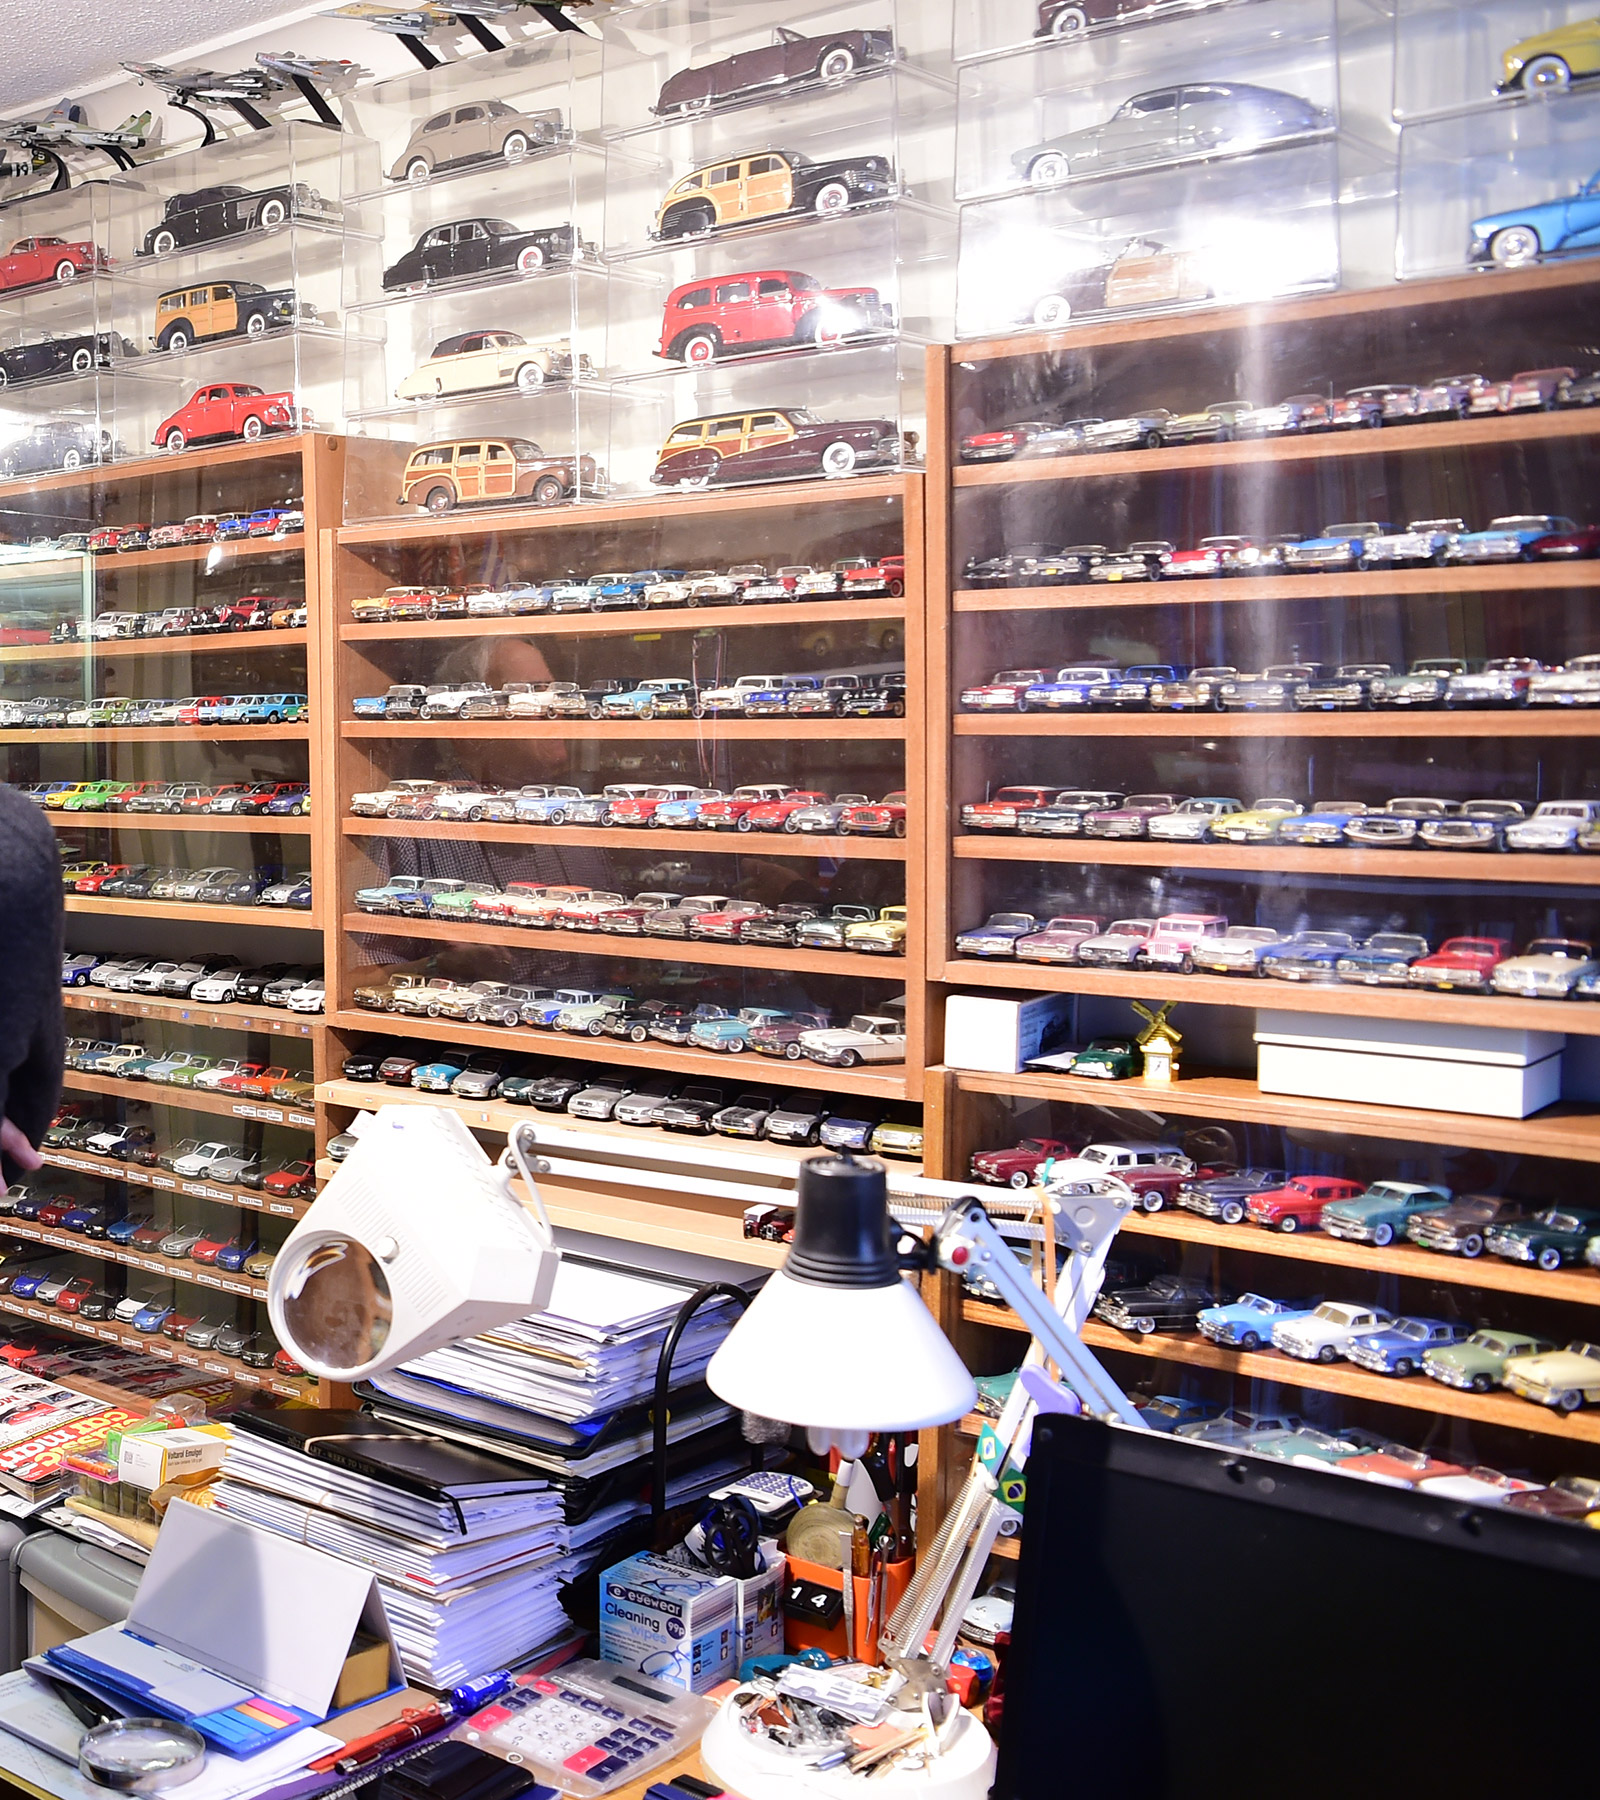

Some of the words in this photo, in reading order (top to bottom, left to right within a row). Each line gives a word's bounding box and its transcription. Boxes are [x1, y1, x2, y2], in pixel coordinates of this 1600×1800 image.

[70, 1411, 129, 1434] car
[167, 1449, 185, 1460] Voltarol
[185, 1447, 203, 1459] Emulgel
[636, 1557, 692, 1578] Cleaning
[628, 1590, 681, 1616] eyewear
[791, 1586, 802, 1600] 1
[811, 1594, 827, 1608] 4
[605, 1602, 660, 1632] Cleaning
[667, 1621, 685, 1637] 99p
[630, 1624, 667, 1645] wipes
